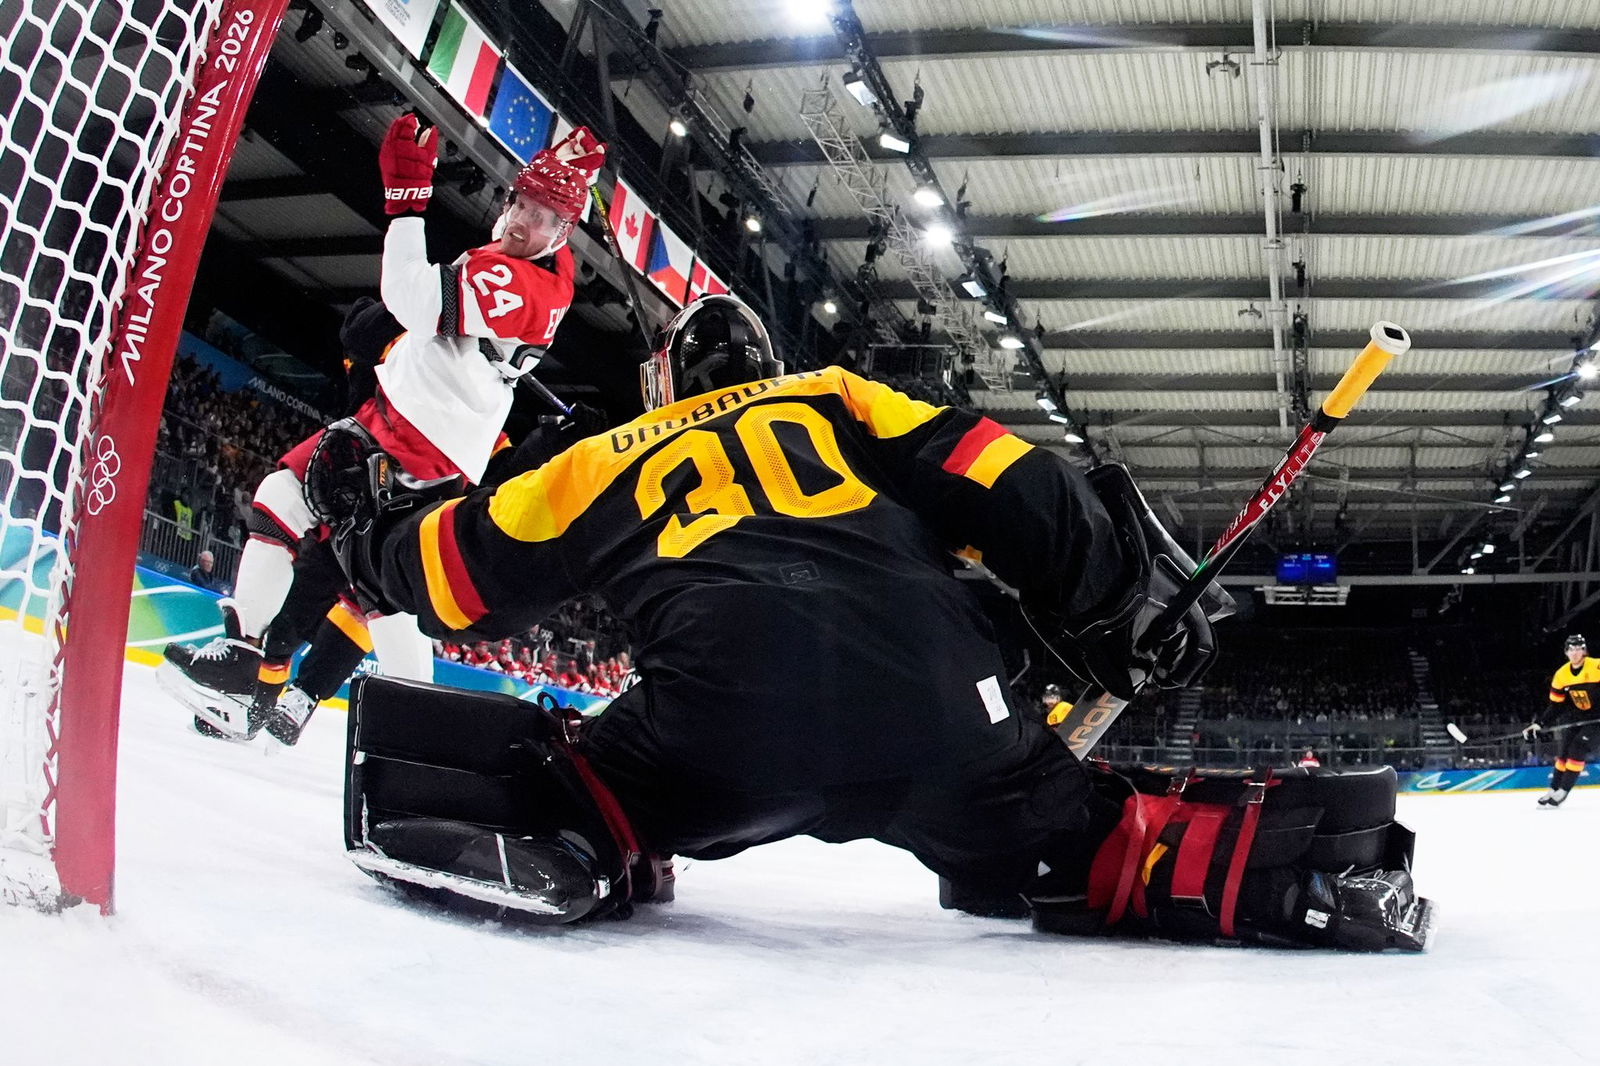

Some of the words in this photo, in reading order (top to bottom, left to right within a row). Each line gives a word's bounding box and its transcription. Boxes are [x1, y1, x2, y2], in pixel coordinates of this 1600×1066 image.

[121, 228, 173, 387] MILANO
[161, 80, 228, 222] CORTINA
[215, 10, 254, 73] 2026
[472, 264, 524, 318] 24
[248, 376, 287, 402] MILANO
[286, 395, 321, 422] CORTINA
[634, 402, 879, 558] 30
[1259, 432, 1322, 512] FLYLITE
